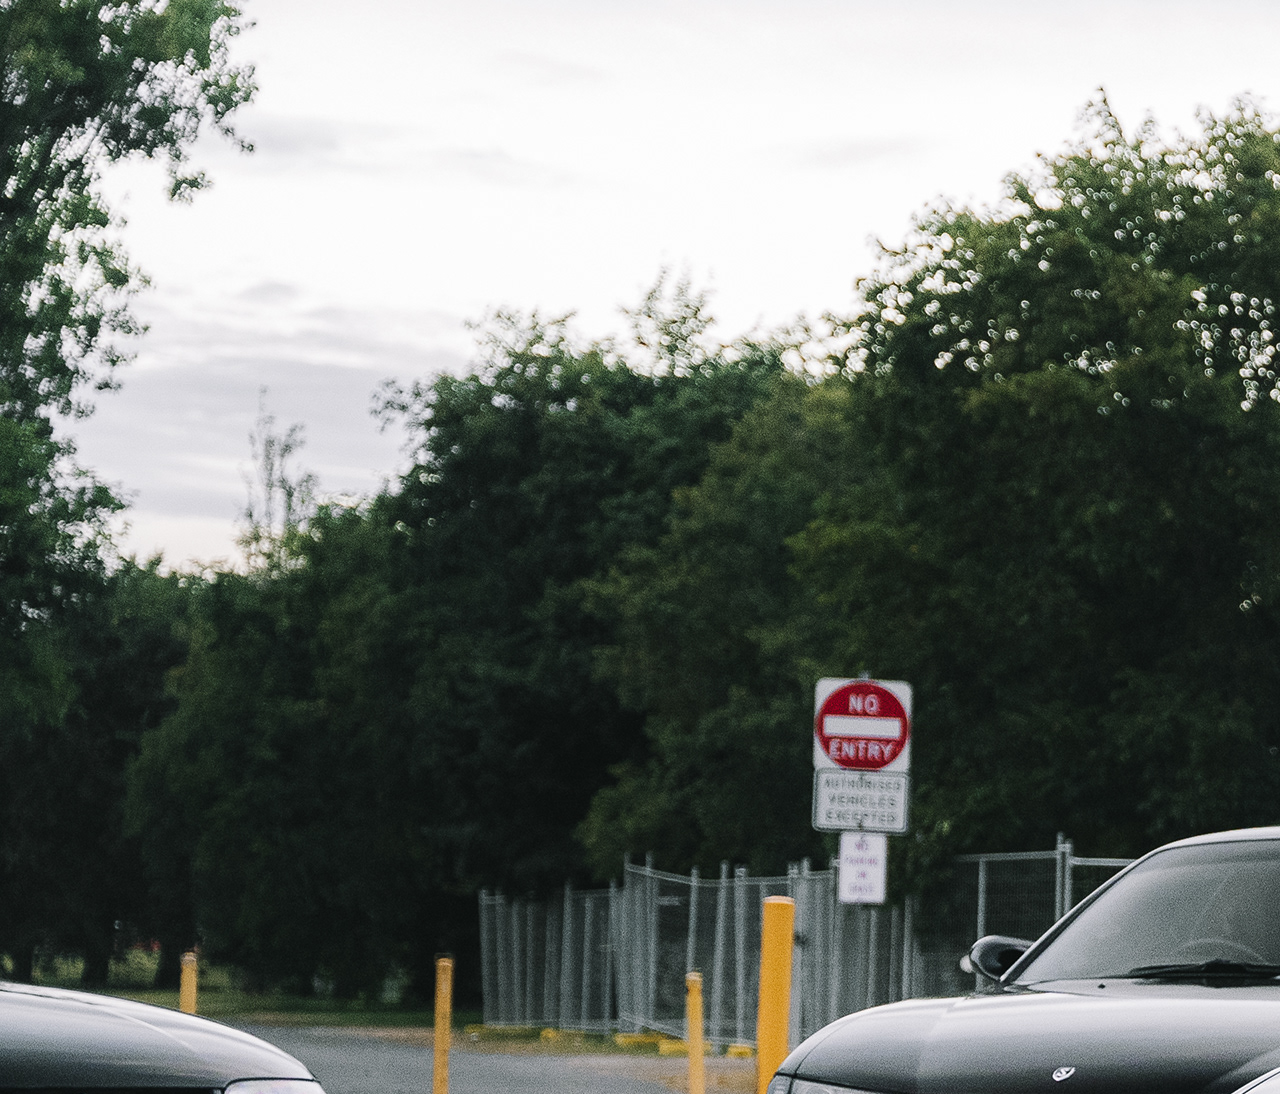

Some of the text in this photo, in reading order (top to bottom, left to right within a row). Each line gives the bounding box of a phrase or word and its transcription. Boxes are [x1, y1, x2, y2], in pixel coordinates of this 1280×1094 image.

[849, 694, 881, 716] NO
[828, 738, 895, 762] ENTRY
[828, 793, 897, 808] VEHICLES
[825, 809, 897, 824] EXCEPTED
